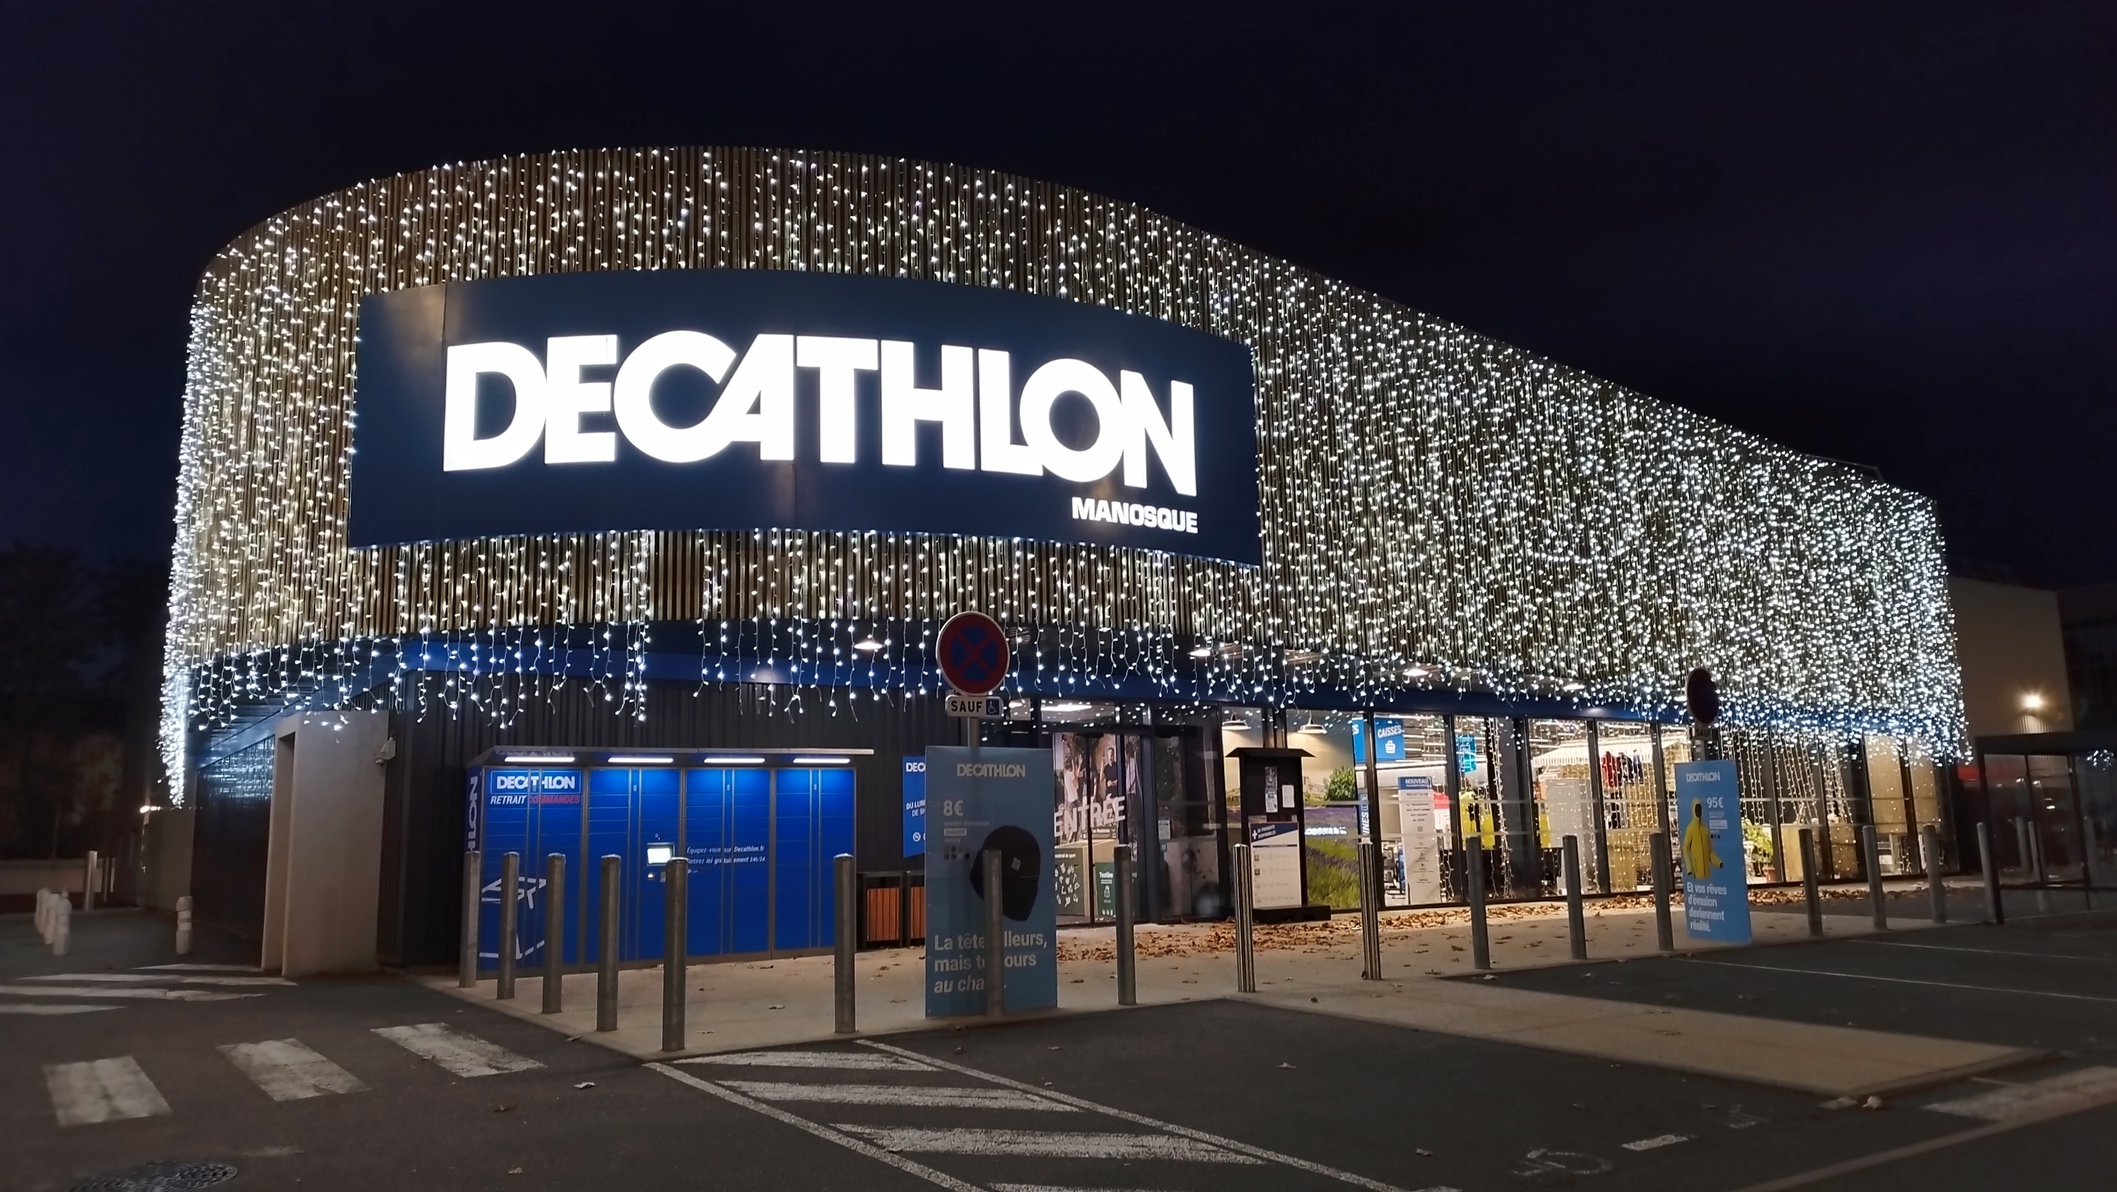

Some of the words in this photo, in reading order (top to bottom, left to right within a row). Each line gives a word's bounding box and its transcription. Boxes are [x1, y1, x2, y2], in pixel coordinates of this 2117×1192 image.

[443, 330, 1198, 497] DECATHLON
[1071, 496, 1198, 535] MANOSQUE
[951, 700, 983, 713] SAUF
[1377, 725, 1402, 739] CAISSES
[956, 763, 1026, 778] DECATHLON
[1686, 771, 1721, 783] DECATHLON
[496, 775, 576, 790] DECATHLON
[490, 795, 527, 805] RETRAIT
[529, 794, 581, 804] COMMANDES
[1706, 796, 1724, 809] 95€
[943, 800, 965, 816] 8€
[1054, 794, 1126, 837] ENTRÉE
[1694, 885, 1706, 894] vos
[1706, 883, 1727, 895] rêves
[1689, 906, 1725, 921] deviennent
[934, 934, 953, 951] La
[934, 954, 972, 972] mais
[933, 979, 953, 994] au
